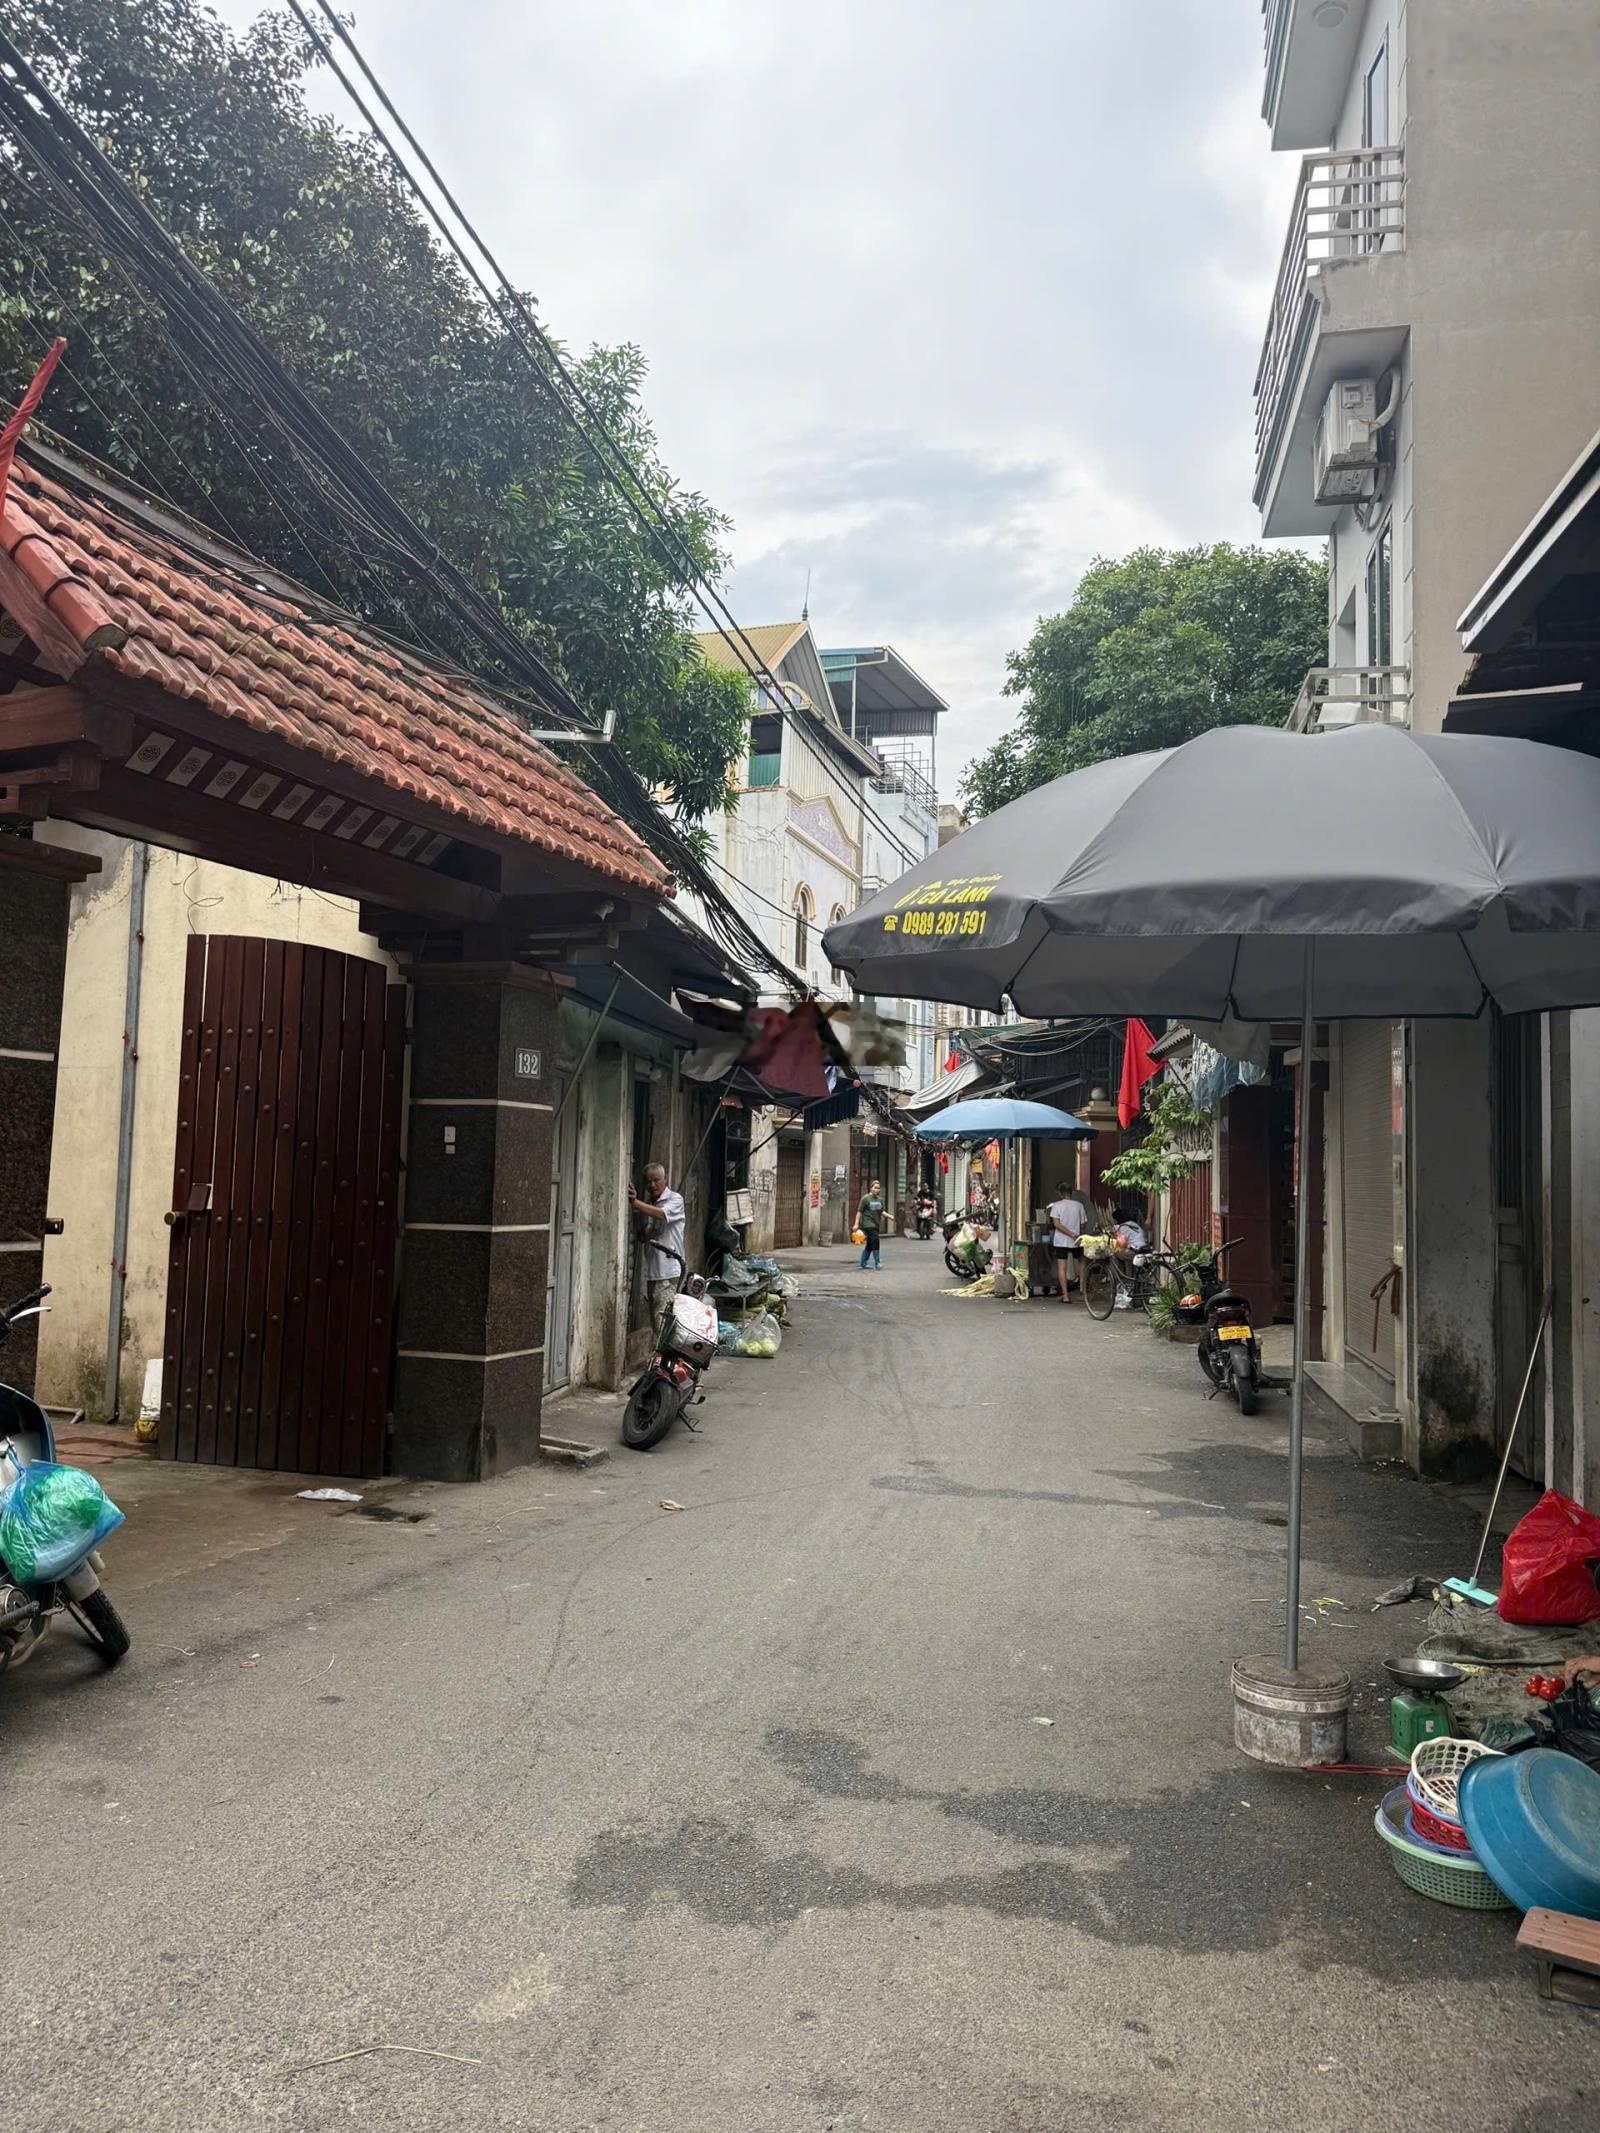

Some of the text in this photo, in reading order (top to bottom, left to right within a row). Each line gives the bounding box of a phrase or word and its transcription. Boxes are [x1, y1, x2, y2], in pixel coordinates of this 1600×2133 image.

[902, 910, 987, 935] 0989 281 591
[518, 1052, 538, 1075] 132
